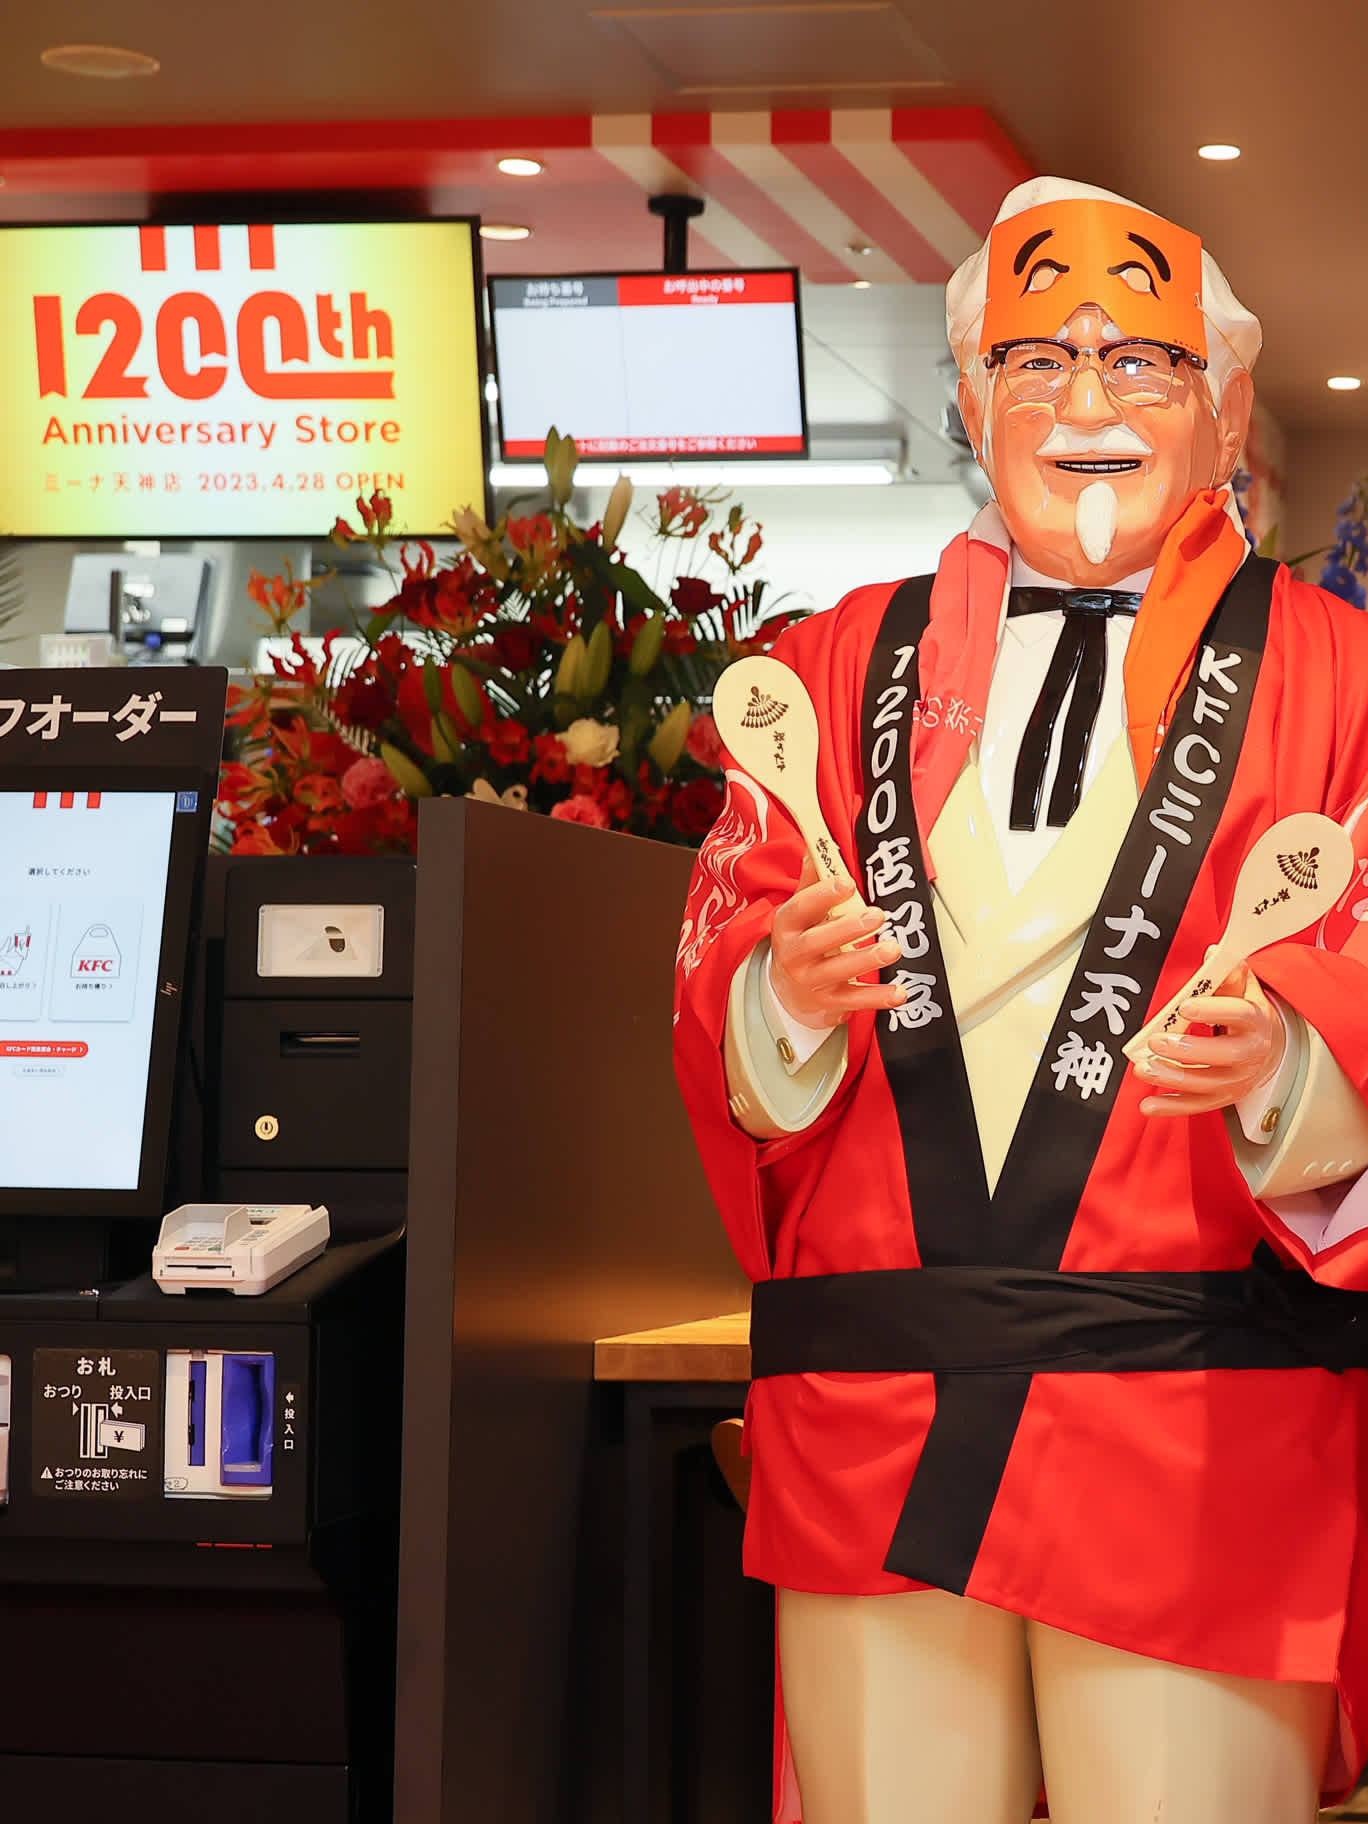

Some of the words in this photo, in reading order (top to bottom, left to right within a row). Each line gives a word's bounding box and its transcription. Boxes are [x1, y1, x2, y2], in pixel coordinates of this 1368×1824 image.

[42, 414, 278, 449] Anniversary
[295, 415, 402, 443] Store
[199, 472, 326, 492] 2023.4.28
[336, 472, 405, 491] OPEN
[1050, 645, 1243, 1100] KFCミーナ天神
[77, 959, 113, 973] KFC
[77, 1357, 117, 1377] お札
[43, 1384, 82, 1399] おつり
[109, 1385, 151, 1401] 投入口
[284, 1408, 296, 1450] 投入口
[54, 1467, 148, 1480] おつりのお取り忘れに
[54, 1480, 120, 1492] ご注意ください
